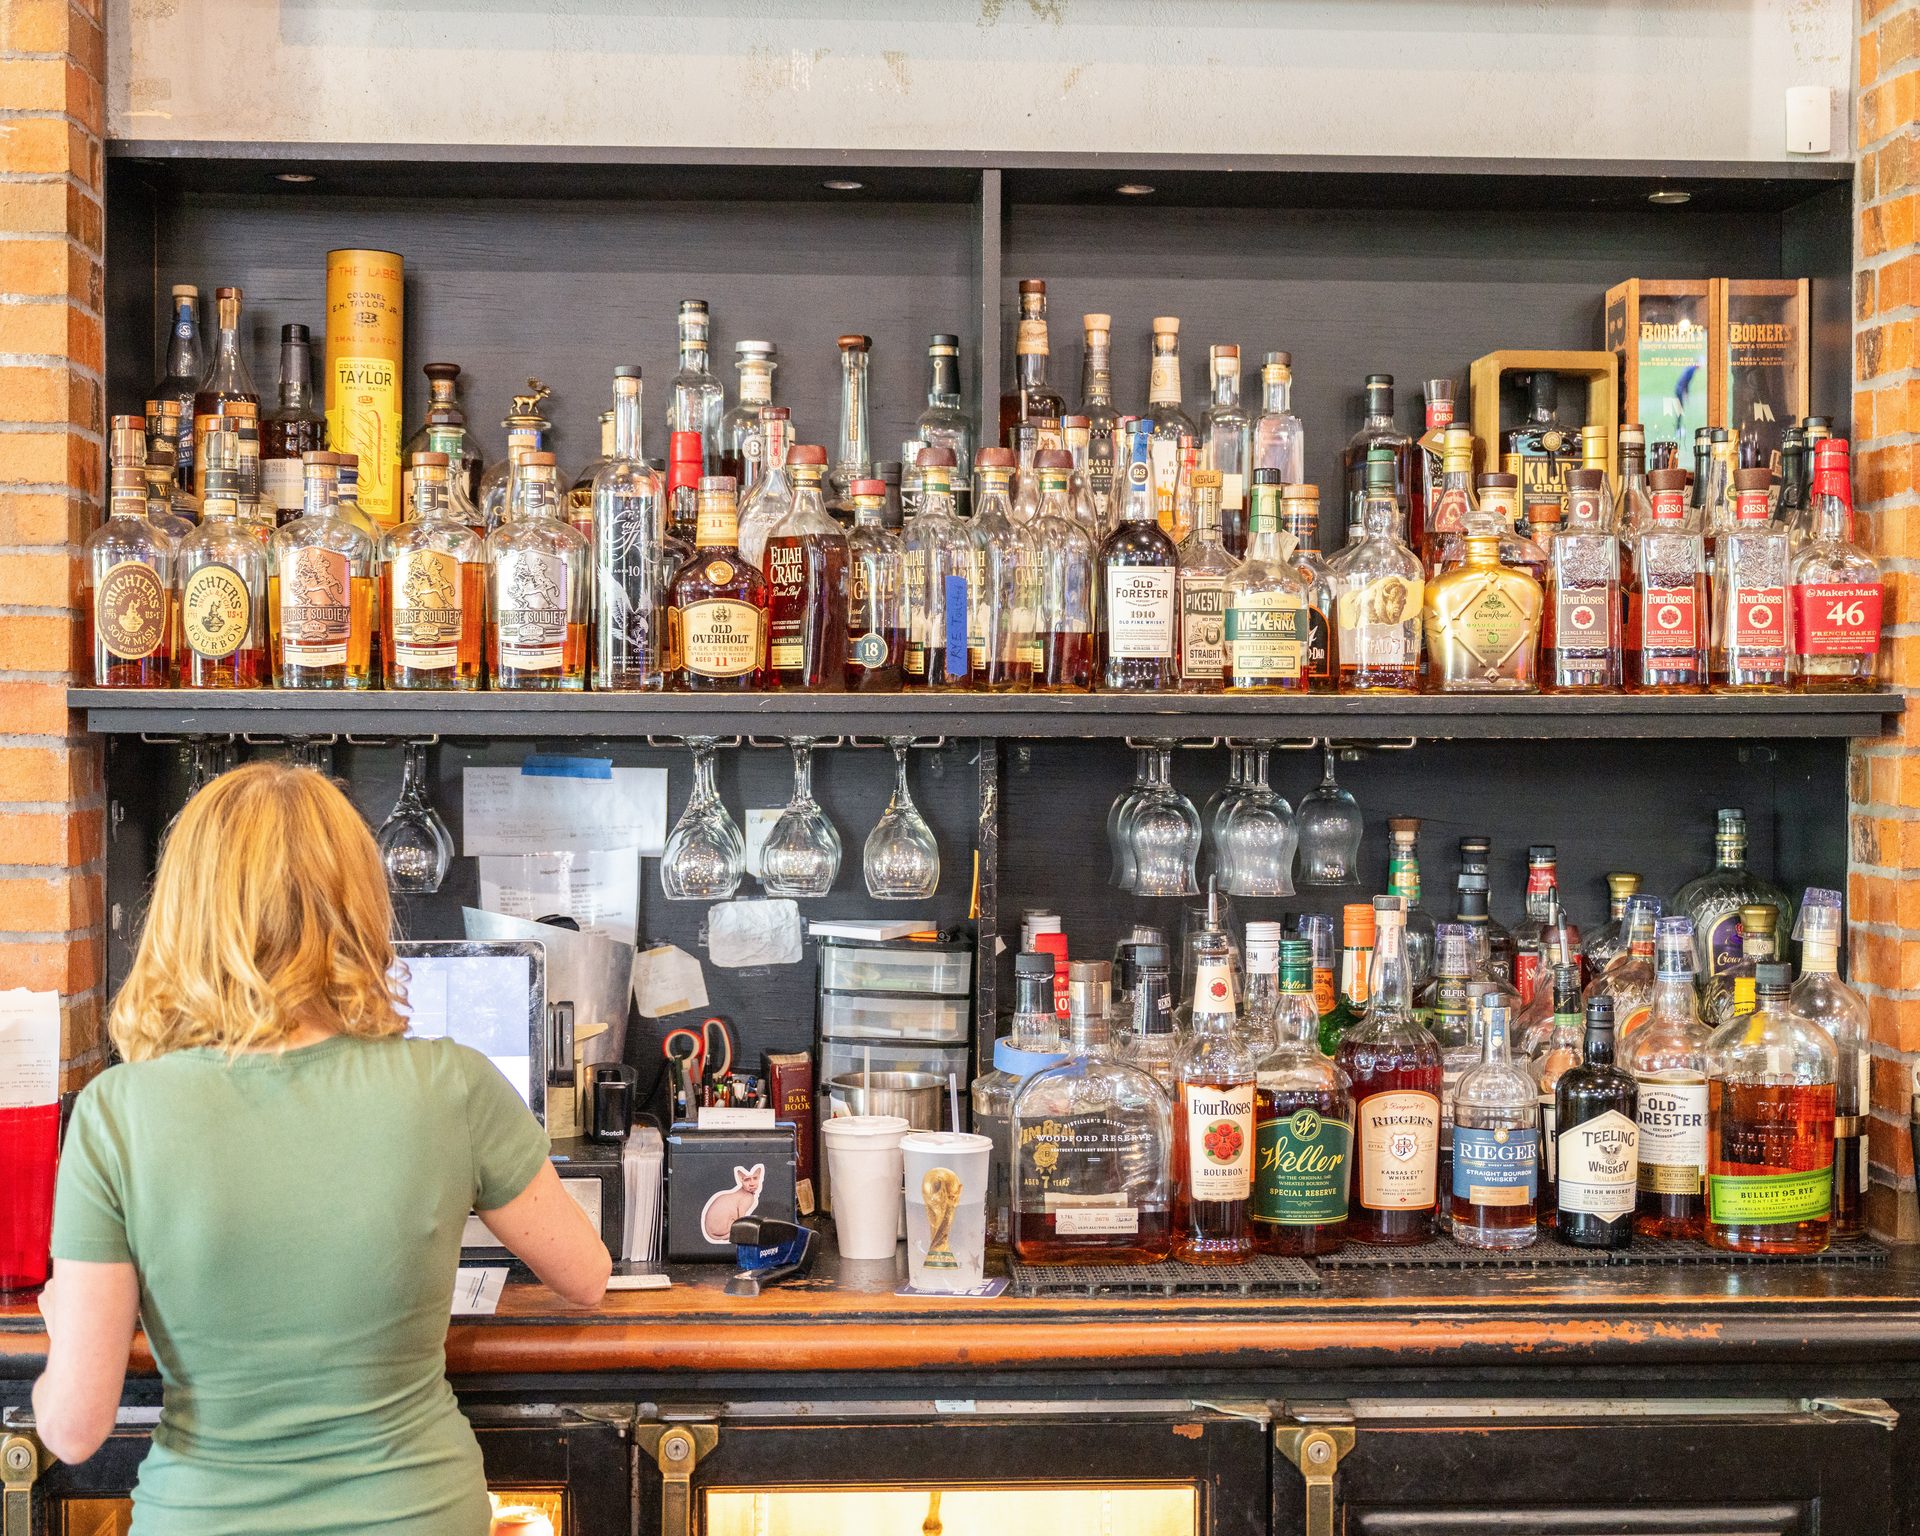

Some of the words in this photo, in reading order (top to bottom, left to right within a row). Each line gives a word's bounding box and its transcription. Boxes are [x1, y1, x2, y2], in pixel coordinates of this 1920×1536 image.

[347, 292, 386, 301] COLONEL
[1642, 323, 1704, 342] BOOKER'S
[1730, 323, 1792, 342] BOOKER'S
[340, 370, 392, 386] TAYLOR
[1743, 504, 1766, 514] OESK
[770, 546, 802, 565] ELIJAH
[629, 566, 640, 577] 10
[770, 565, 803, 586] CRAIG
[1133, 580, 1153, 588] OLD
[1116, 588, 1168, 598] FORESTER
[1816, 589, 1854, 597] Maker's
[1855, 588, 1878, 597] Mark
[310, 607, 349, 622] SOLDIER
[423, 609, 461, 624] SOLDIER
[527, 610, 566, 626] SOLDIER
[1131, 610, 1155, 619] 1910
[1268, 612, 1296, 621] HENRY
[1826, 601, 1864, 626] 46
[108, 624, 131, 645] SOUR
[133, 626, 156, 645] MASH
[711, 624, 732, 634] OLD
[692, 634, 750, 644] OVERHOLT
[864, 642, 878, 657] 18
[1190, 650, 1220, 659] STRAIGHT
[714, 657, 729, 667] 11
[788, 1095, 807, 1103] BAR
[1648, 1098, 1676, 1111] OLD
[784, 1102, 811, 1112] BOOK
[1371, 1116, 1434, 1128] RIEGER'S
[601, 1129, 624, 1138] Scotch
[1036, 1134, 1098, 1142] WOODFORD
[1102, 1133, 1153, 1142] RESERVE
[1582, 1130, 1635, 1147] TEELING
[1261, 1136, 1344, 1172] Weller
[1460, 1143, 1536, 1160] RIEGER
[1204, 1168, 1243, 1176] BOURBON
[1588, 1160, 1629, 1174] WHISKEY
[1466, 1169, 1501, 1177] STRAIGHT
[1503, 1169, 1532, 1177] BOURBON
[1041, 1176, 1050, 1188] 7
[1269, 1188, 1302, 1196] SPECIAL
[1305, 1188, 1337, 1196] RESERVE
[1741, 1190, 1779, 1199] BULLEIT
[1782, 1189, 1796, 1197] 95
[1798, 1187, 1814, 1195] RYE
